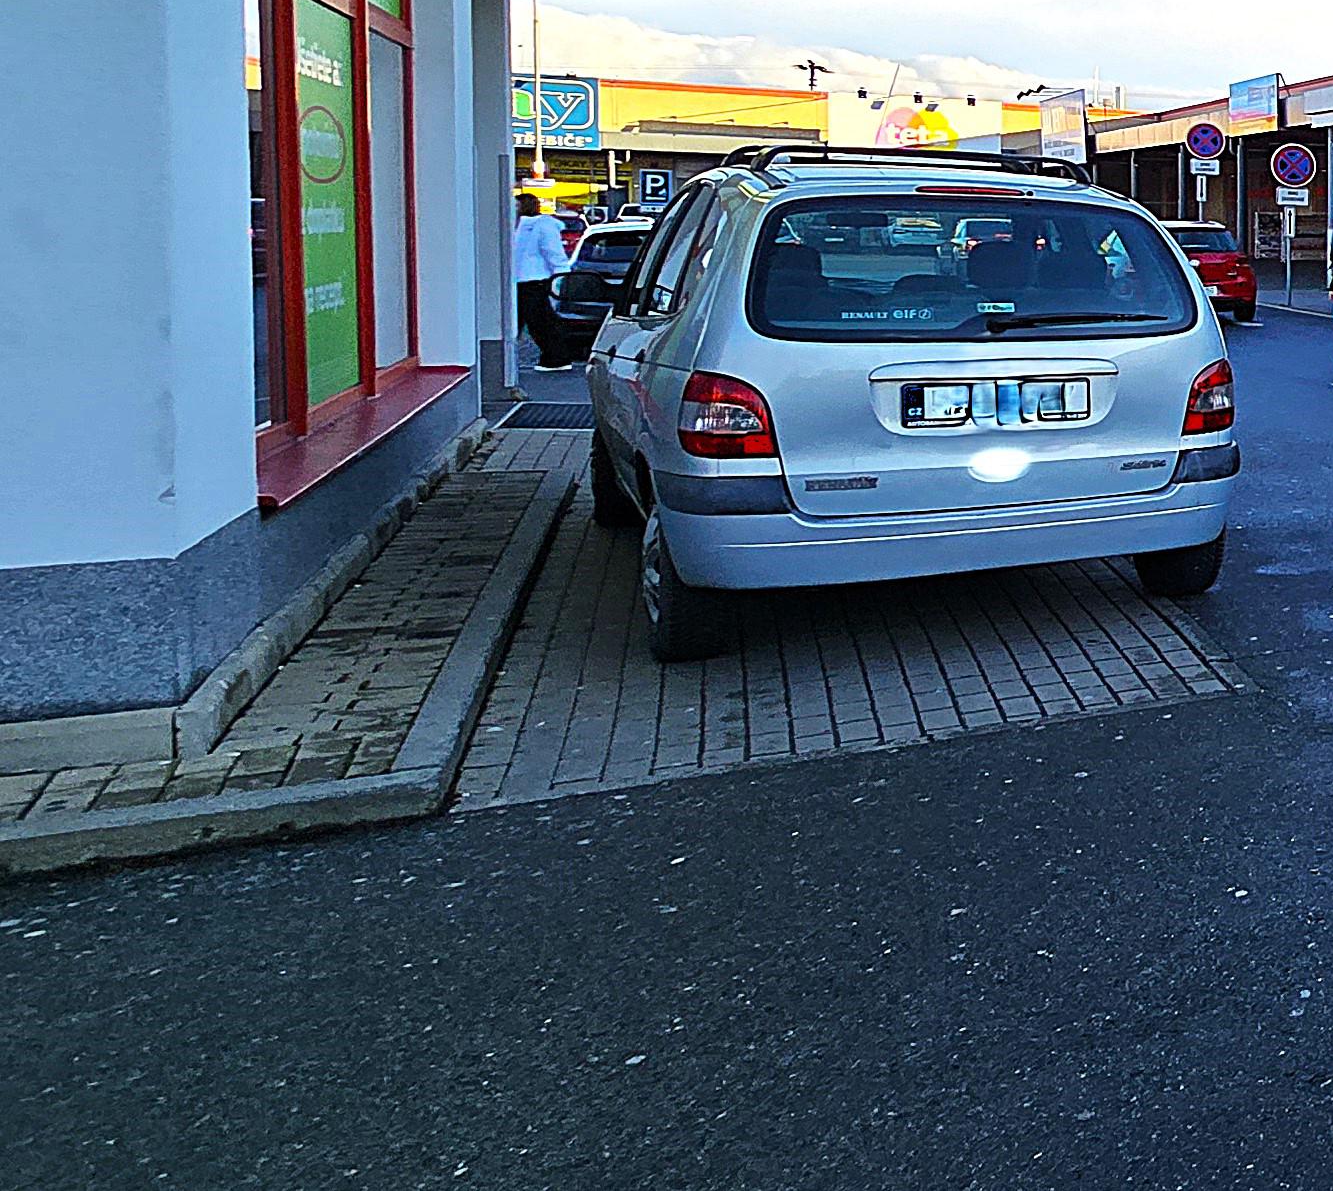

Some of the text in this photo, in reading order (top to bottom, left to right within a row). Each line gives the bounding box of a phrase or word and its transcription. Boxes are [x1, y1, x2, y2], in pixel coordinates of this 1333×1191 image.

[884, 121, 949, 147] teta
[842, 308, 916, 319] RENAULT elf
[908, 407, 923, 416] CZ
